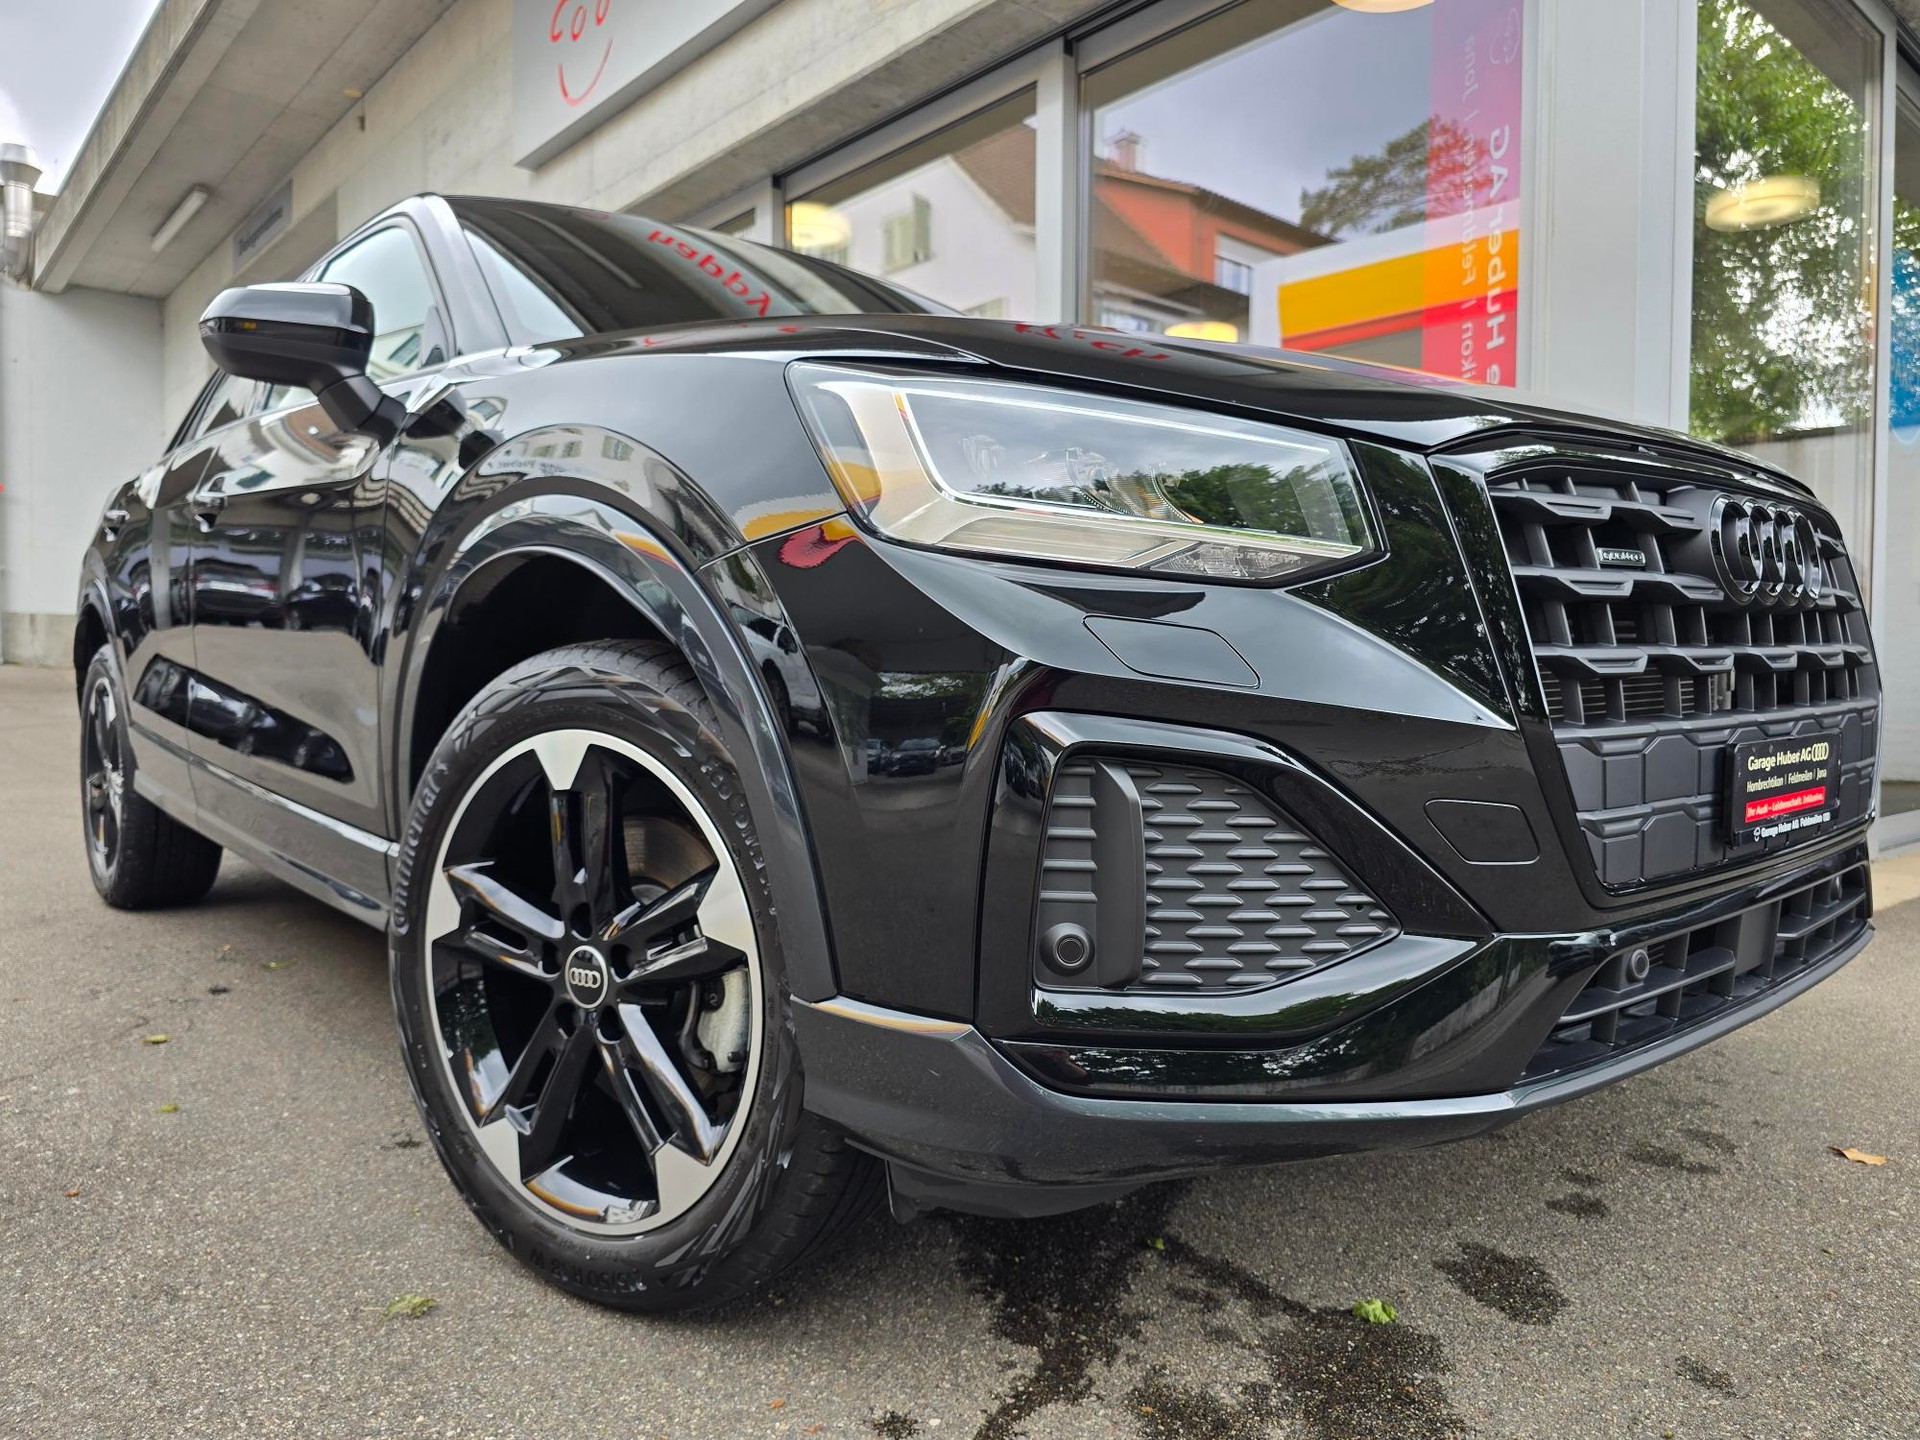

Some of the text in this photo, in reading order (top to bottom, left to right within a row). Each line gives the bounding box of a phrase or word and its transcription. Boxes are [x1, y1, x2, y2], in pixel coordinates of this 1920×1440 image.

[1748, 747, 1812, 771] Garage Huber AG
[1816, 767, 1828, 781] Jona
